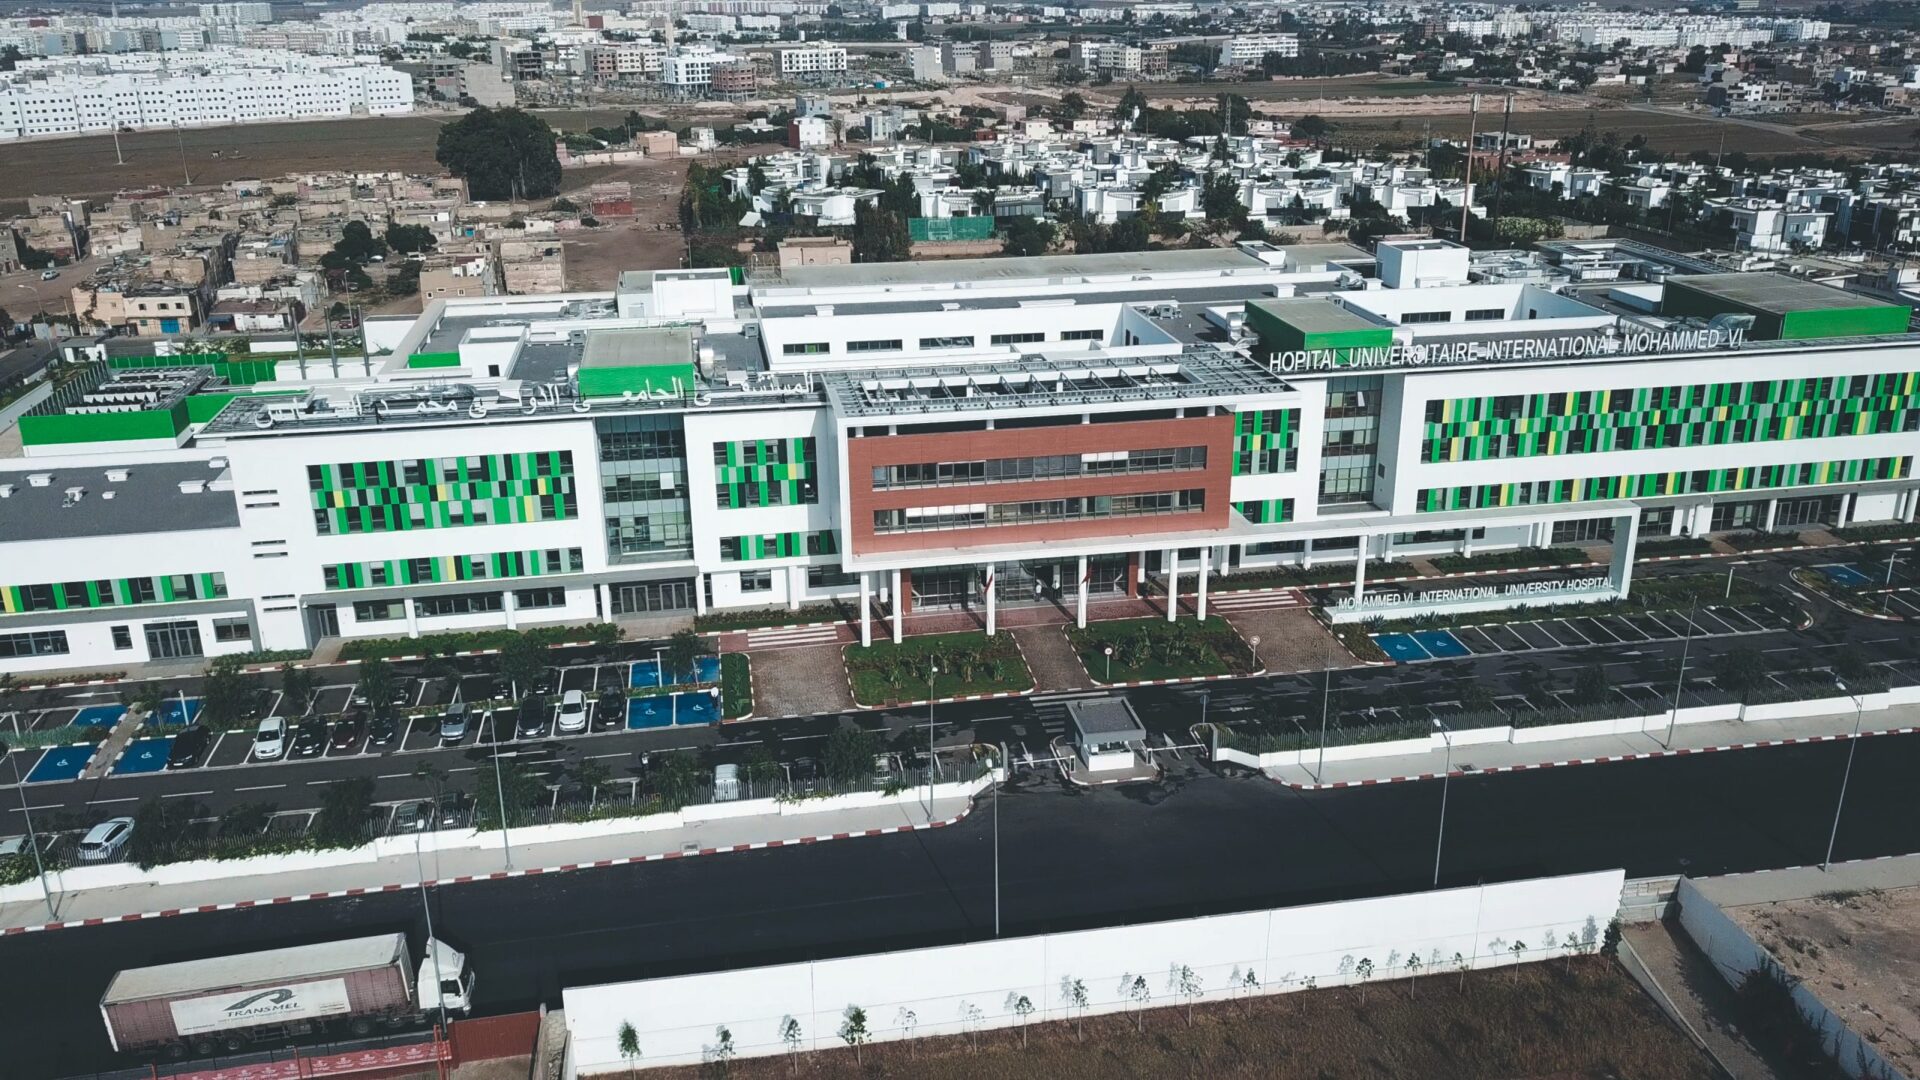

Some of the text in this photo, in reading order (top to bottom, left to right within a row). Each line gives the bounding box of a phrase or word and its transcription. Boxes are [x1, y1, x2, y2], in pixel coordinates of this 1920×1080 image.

[1269, 327, 1744, 373] HOPITAL UNIVERSITAIRE INTERNATIONAL MOHAMMED VI
[1403, 592, 1414, 605] VI
[1420, 586, 1500, 603] INTERNATIONAL
[1505, 580, 1565, 596] UNIVERSITY
[1566, 576, 1615, 591] HOSPITAL
[227, 1002, 301, 1018] TRANSMEL
